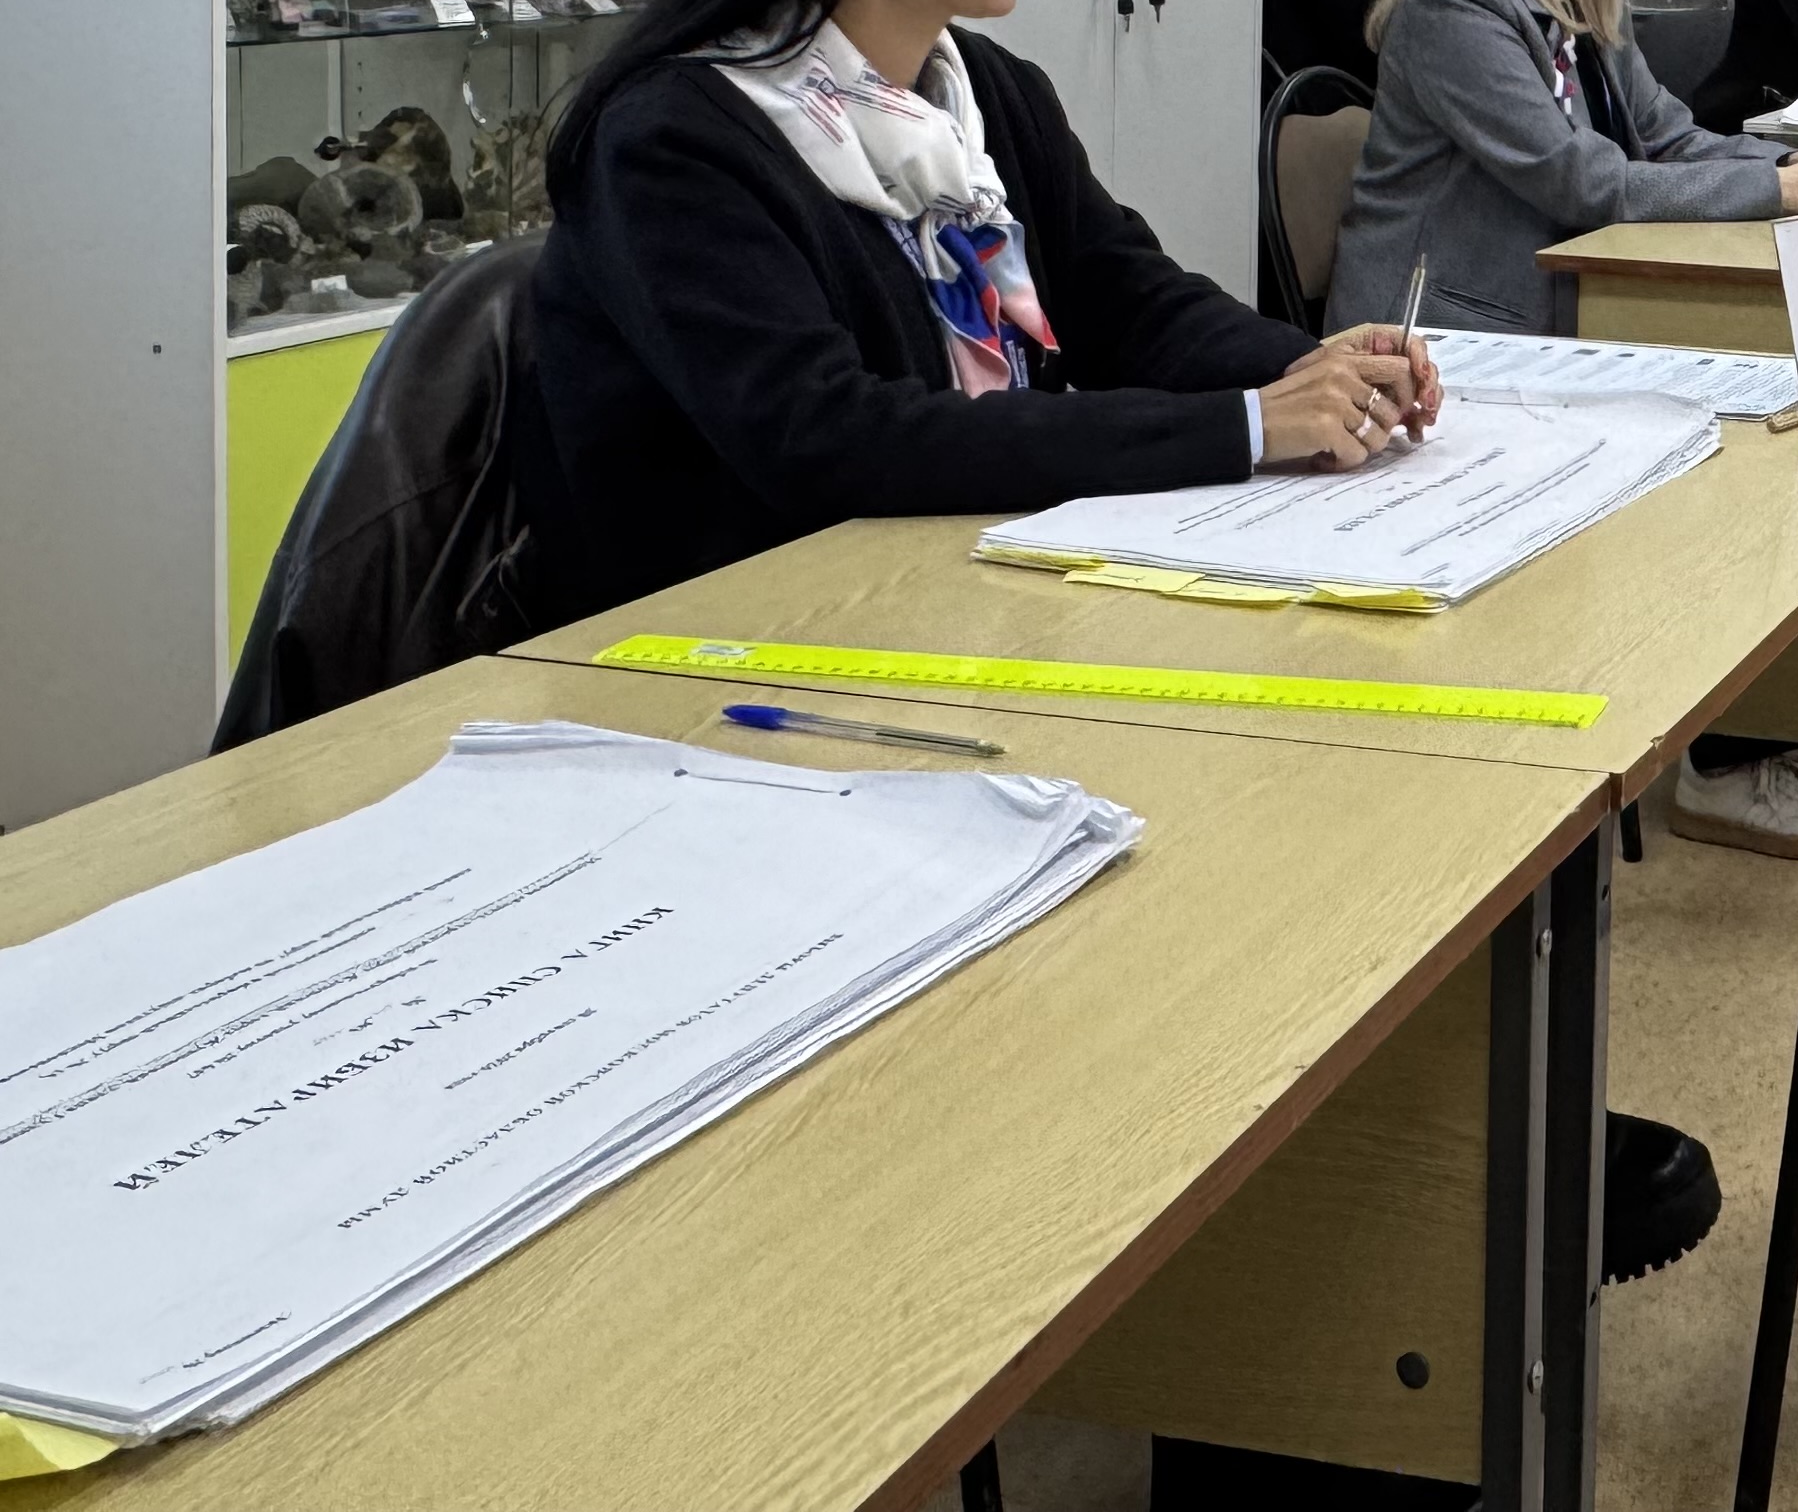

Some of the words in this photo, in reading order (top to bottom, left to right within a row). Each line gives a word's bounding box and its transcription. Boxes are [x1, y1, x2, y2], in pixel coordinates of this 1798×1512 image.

[559, 903, 675, 965] КНИГА
[409, 961, 564, 1036] СПИСКА
[109, 1035, 414, 1196] ИЗБИРАТЕЛЕЙ
